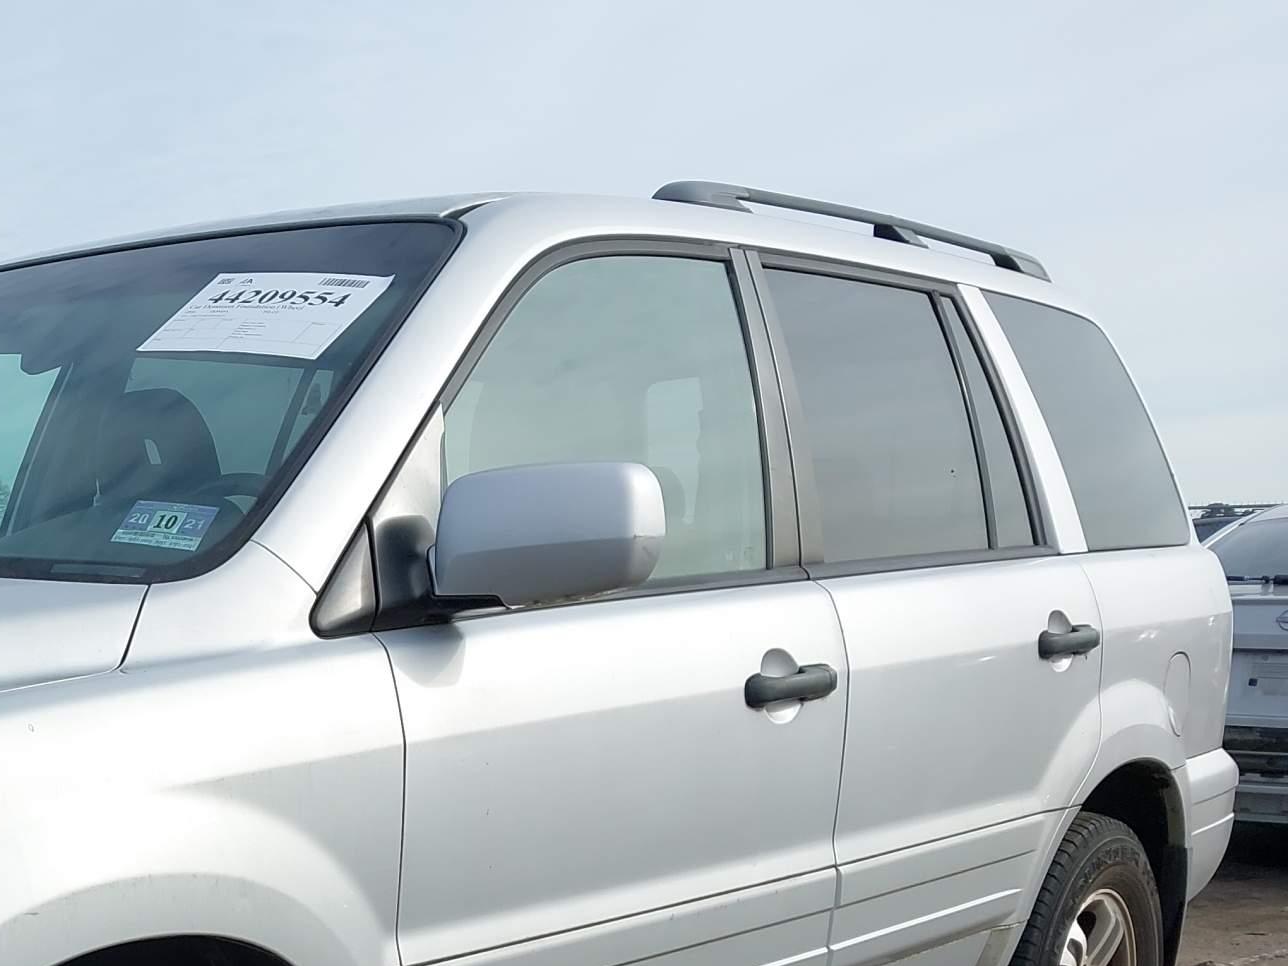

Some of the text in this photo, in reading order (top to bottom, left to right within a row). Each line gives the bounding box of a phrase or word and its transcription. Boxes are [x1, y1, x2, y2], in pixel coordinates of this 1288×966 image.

[209, 290, 352, 307] 44209554
[129, 513, 149, 524] 20
[153, 514, 179, 530] 10
